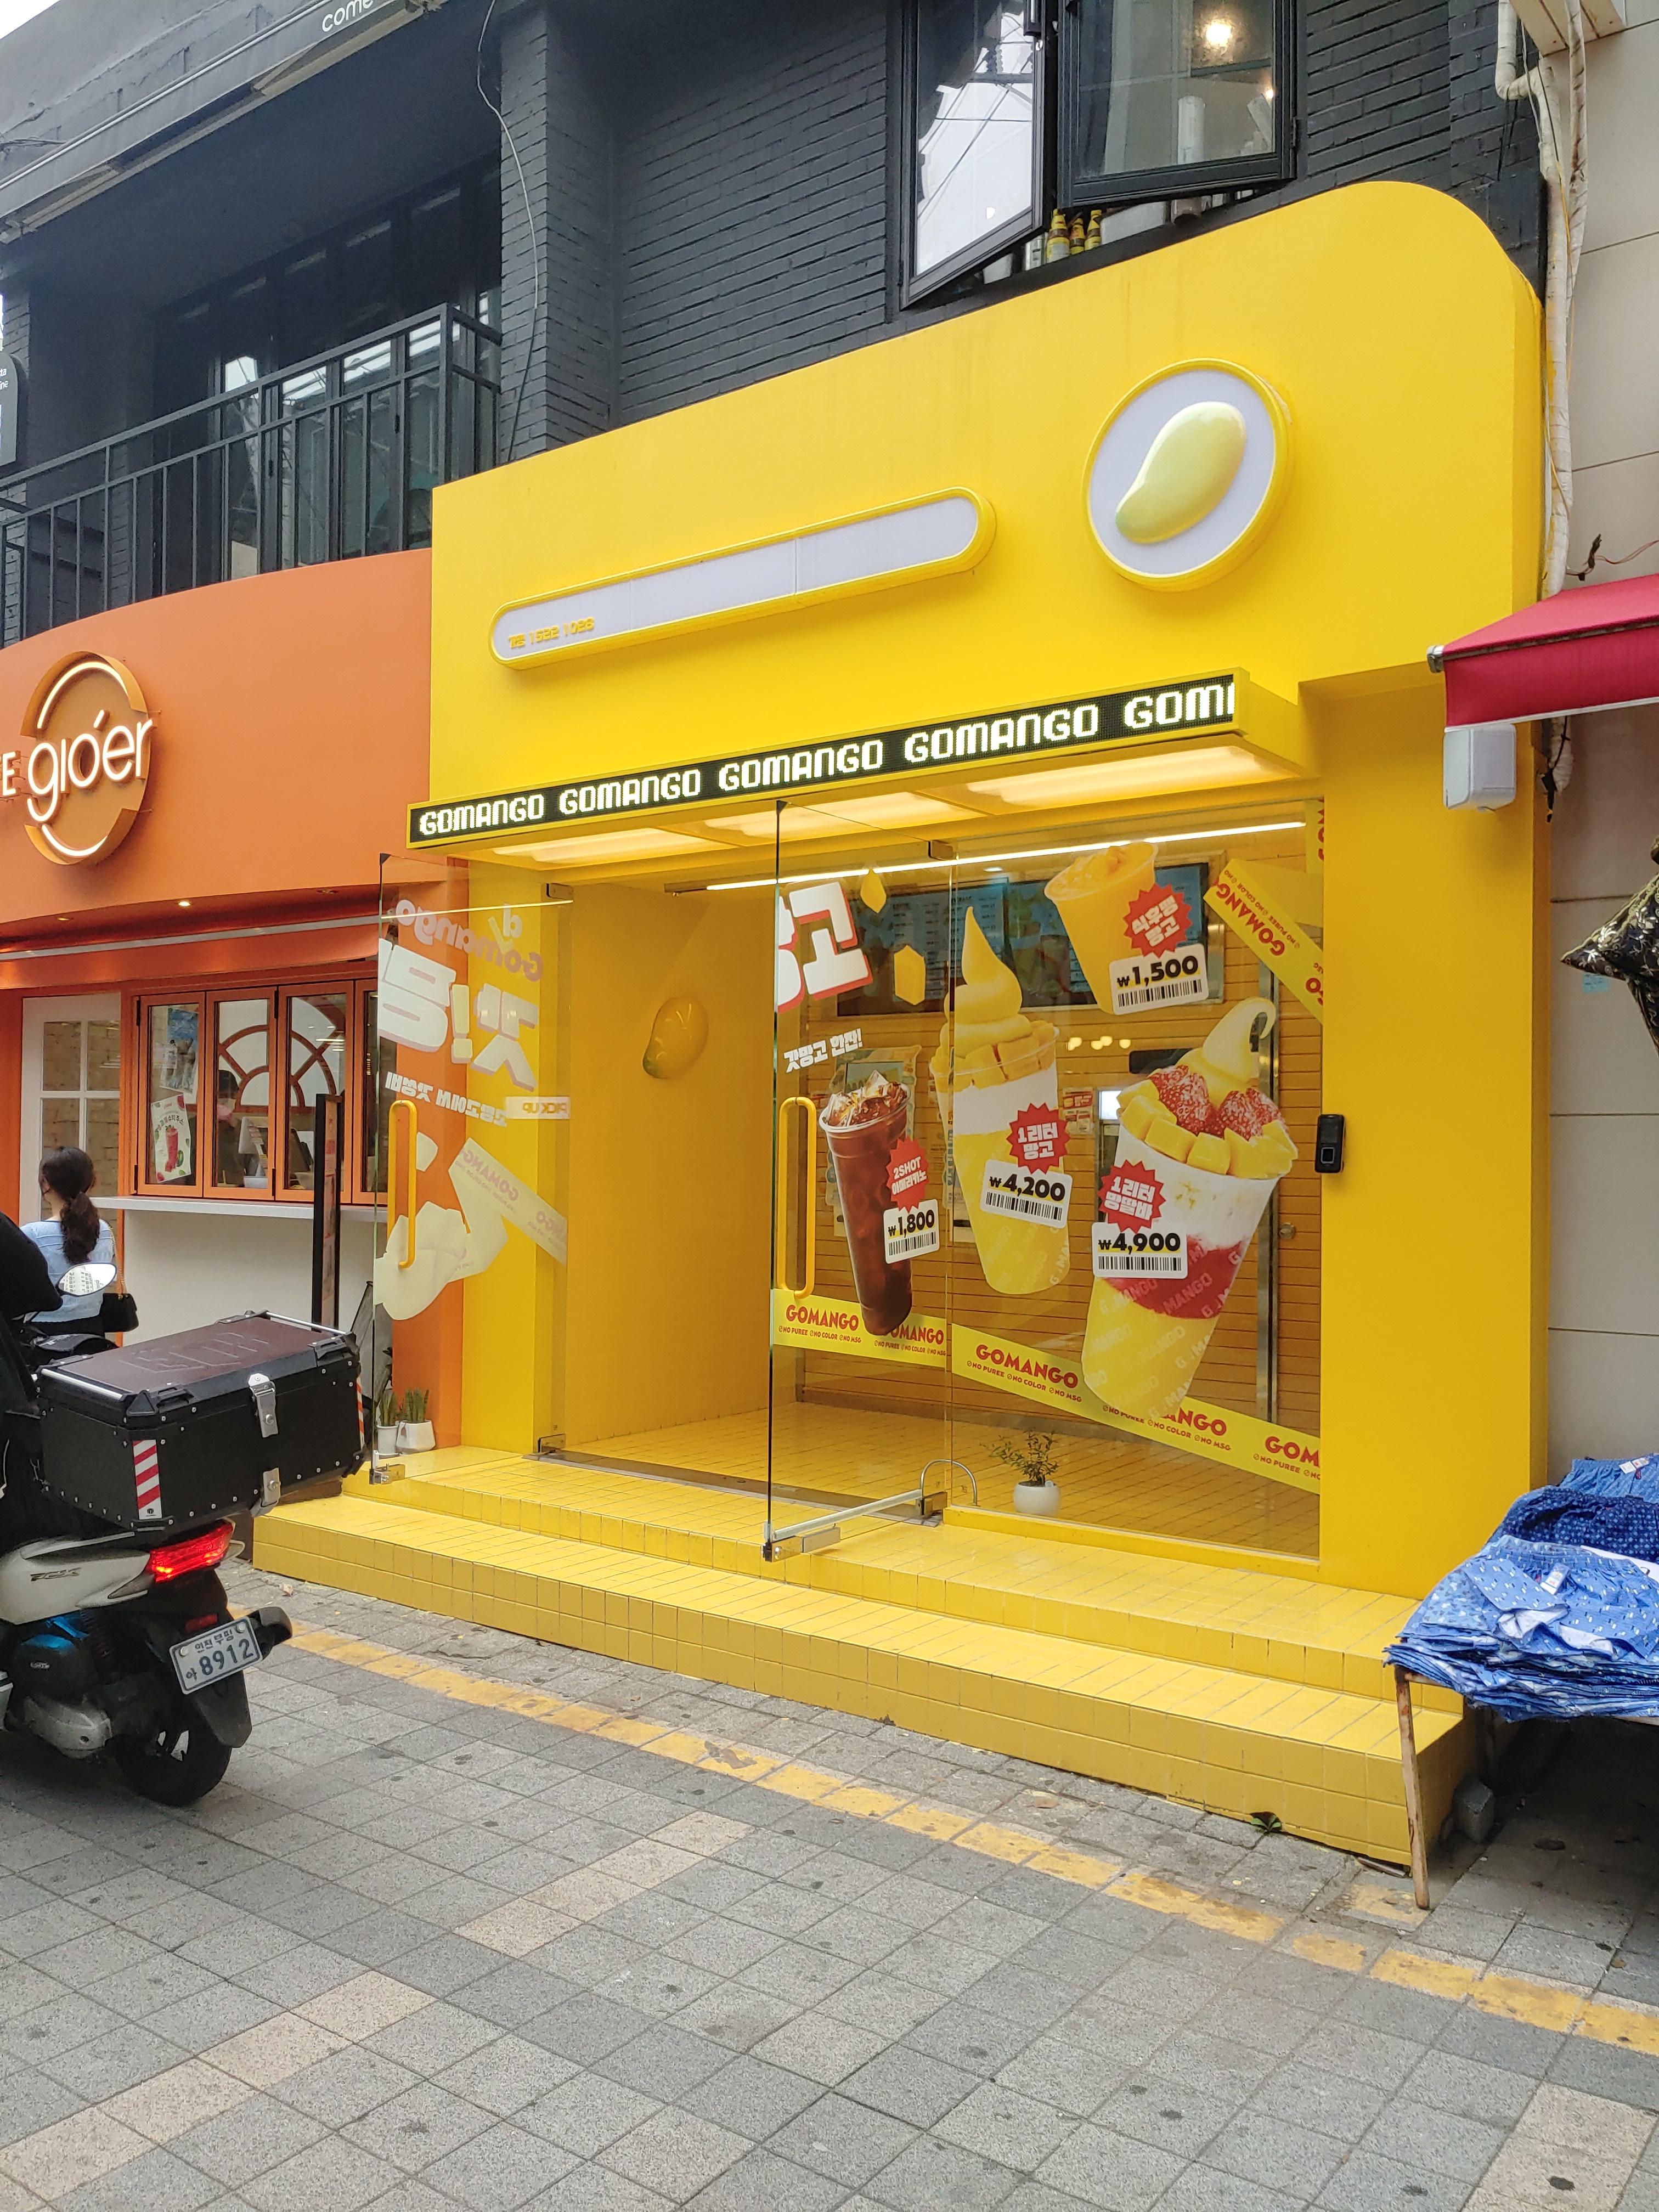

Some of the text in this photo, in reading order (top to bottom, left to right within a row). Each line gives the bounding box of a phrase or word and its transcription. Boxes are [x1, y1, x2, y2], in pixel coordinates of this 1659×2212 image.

[322, 0, 374, 32] come
[419, 682, 1235, 836] GOMANGO GOMANGO GOMANGO GOMANGO GOM
[1145, 915, 1180, 947] 망고
[1117, 955, 1198, 988] ₩1,500
[783, 1028, 864, 1074] 갓망고 한잔!
[1018, 1122, 1059, 1144] 1리터
[1023, 1140, 1055, 1160] 망고
[893, 1156, 922, 1180] 2SHOT
[989, 1173, 1066, 1201] ₩4,200
[1110, 1176, 1155, 1203] 1리터
[888, 1209, 935, 1238] ₩1,800
[1098, 1233, 1181, 1255] ₩4,900
[786, 1304, 859, 1331] GOMANGO
[821, 1331, 838, 1340] COLOR
[890, 1324, 944, 1345] OMANGO
[976, 1344, 1079, 1389] GOMANGO
[972, 1362, 1082, 1403] NO PUREE NO COLOR NO MSG
[1154, 1421, 1165, 1430] NO
[1166, 1425, 1192, 1439] COLOR
[1201, 1436, 1212, 1446] NO
[1213, 1441, 1232, 1451] MSG
[1260, 1455, 1272, 1465] NO
[1273, 1460, 1301, 1474] PUREE
[195, 1638, 214, 1654] 인천
[199, 1638, 254, 1676] 8912
